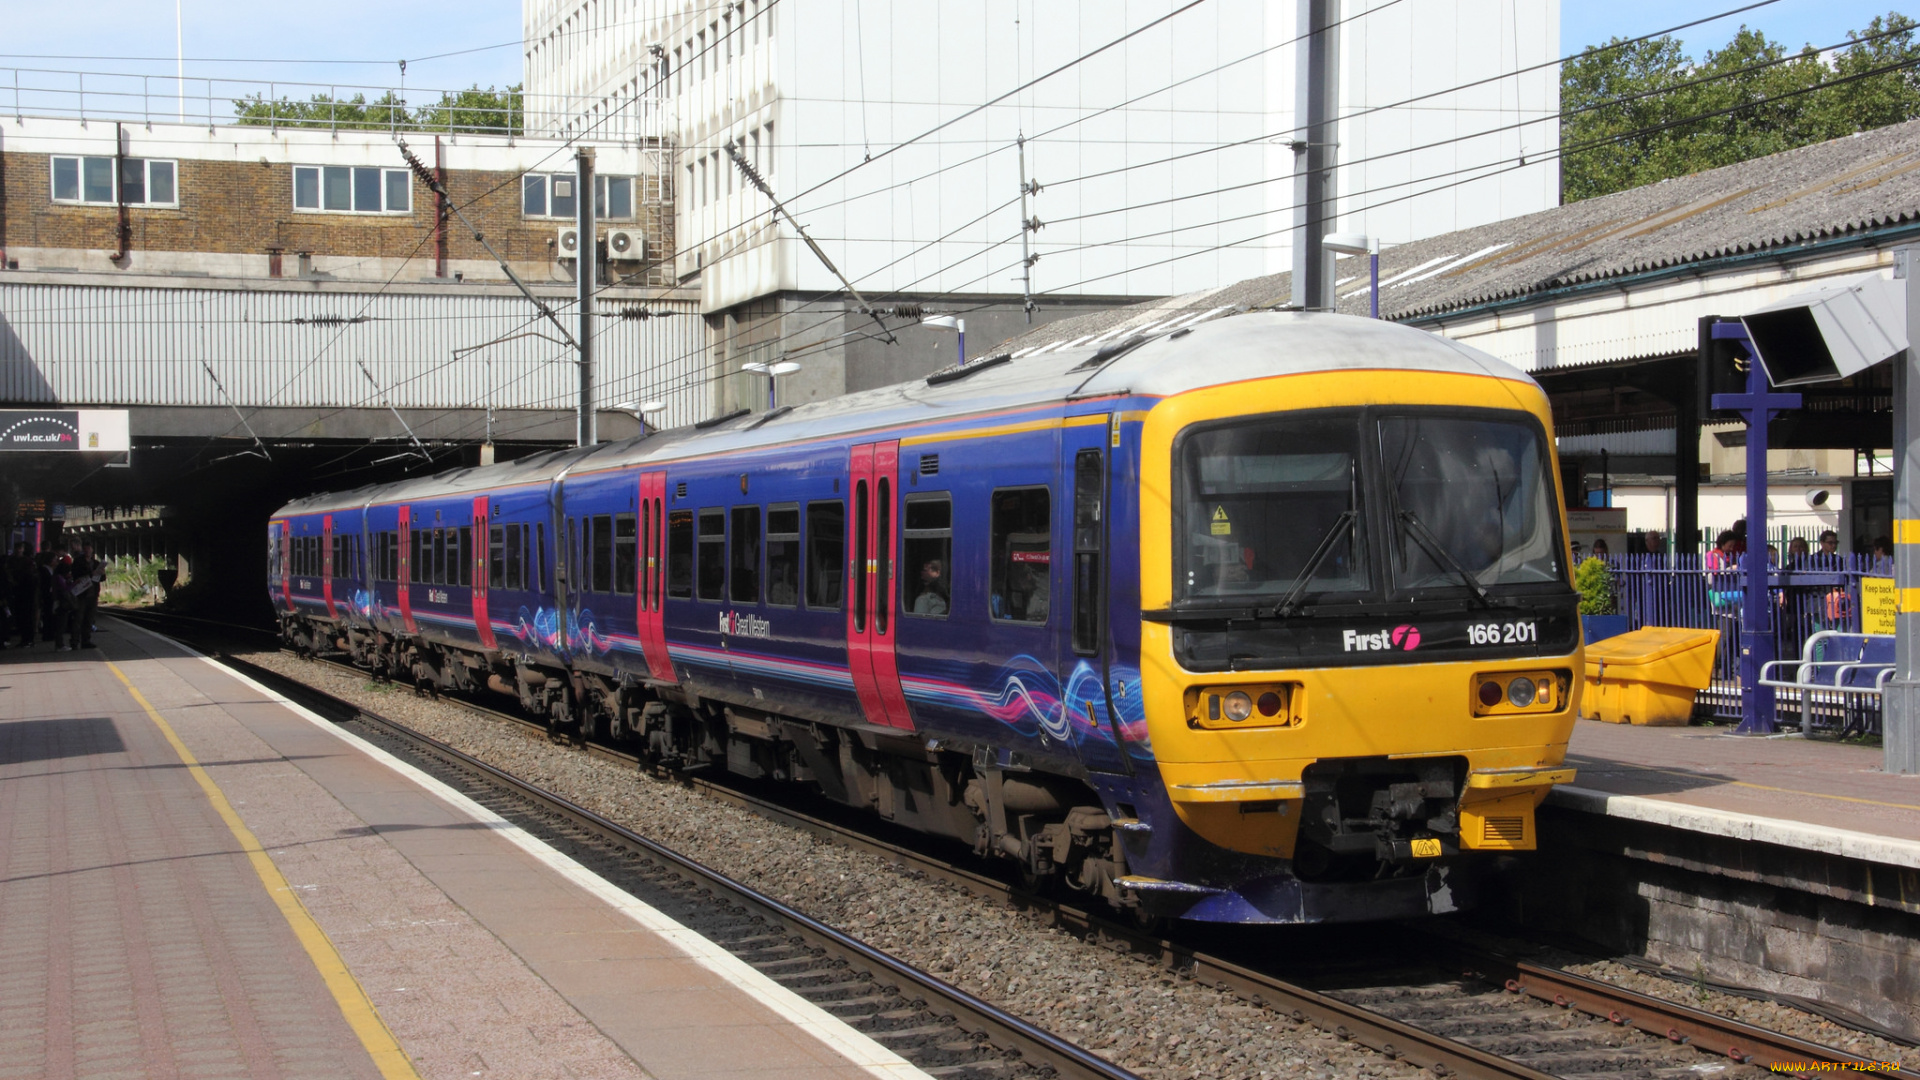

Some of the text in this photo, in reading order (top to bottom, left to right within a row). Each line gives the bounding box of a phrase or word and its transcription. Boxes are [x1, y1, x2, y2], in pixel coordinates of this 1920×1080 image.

[13, 433, 72, 442] uwl.ac.uk/94
[1865, 584, 1878, 595] Keep
[1879, 585, 1891, 593] back
[1866, 606, 1887, 618] Passing
[1467, 622, 1537, 645] 166 201
[1343, 629, 1391, 651] First
